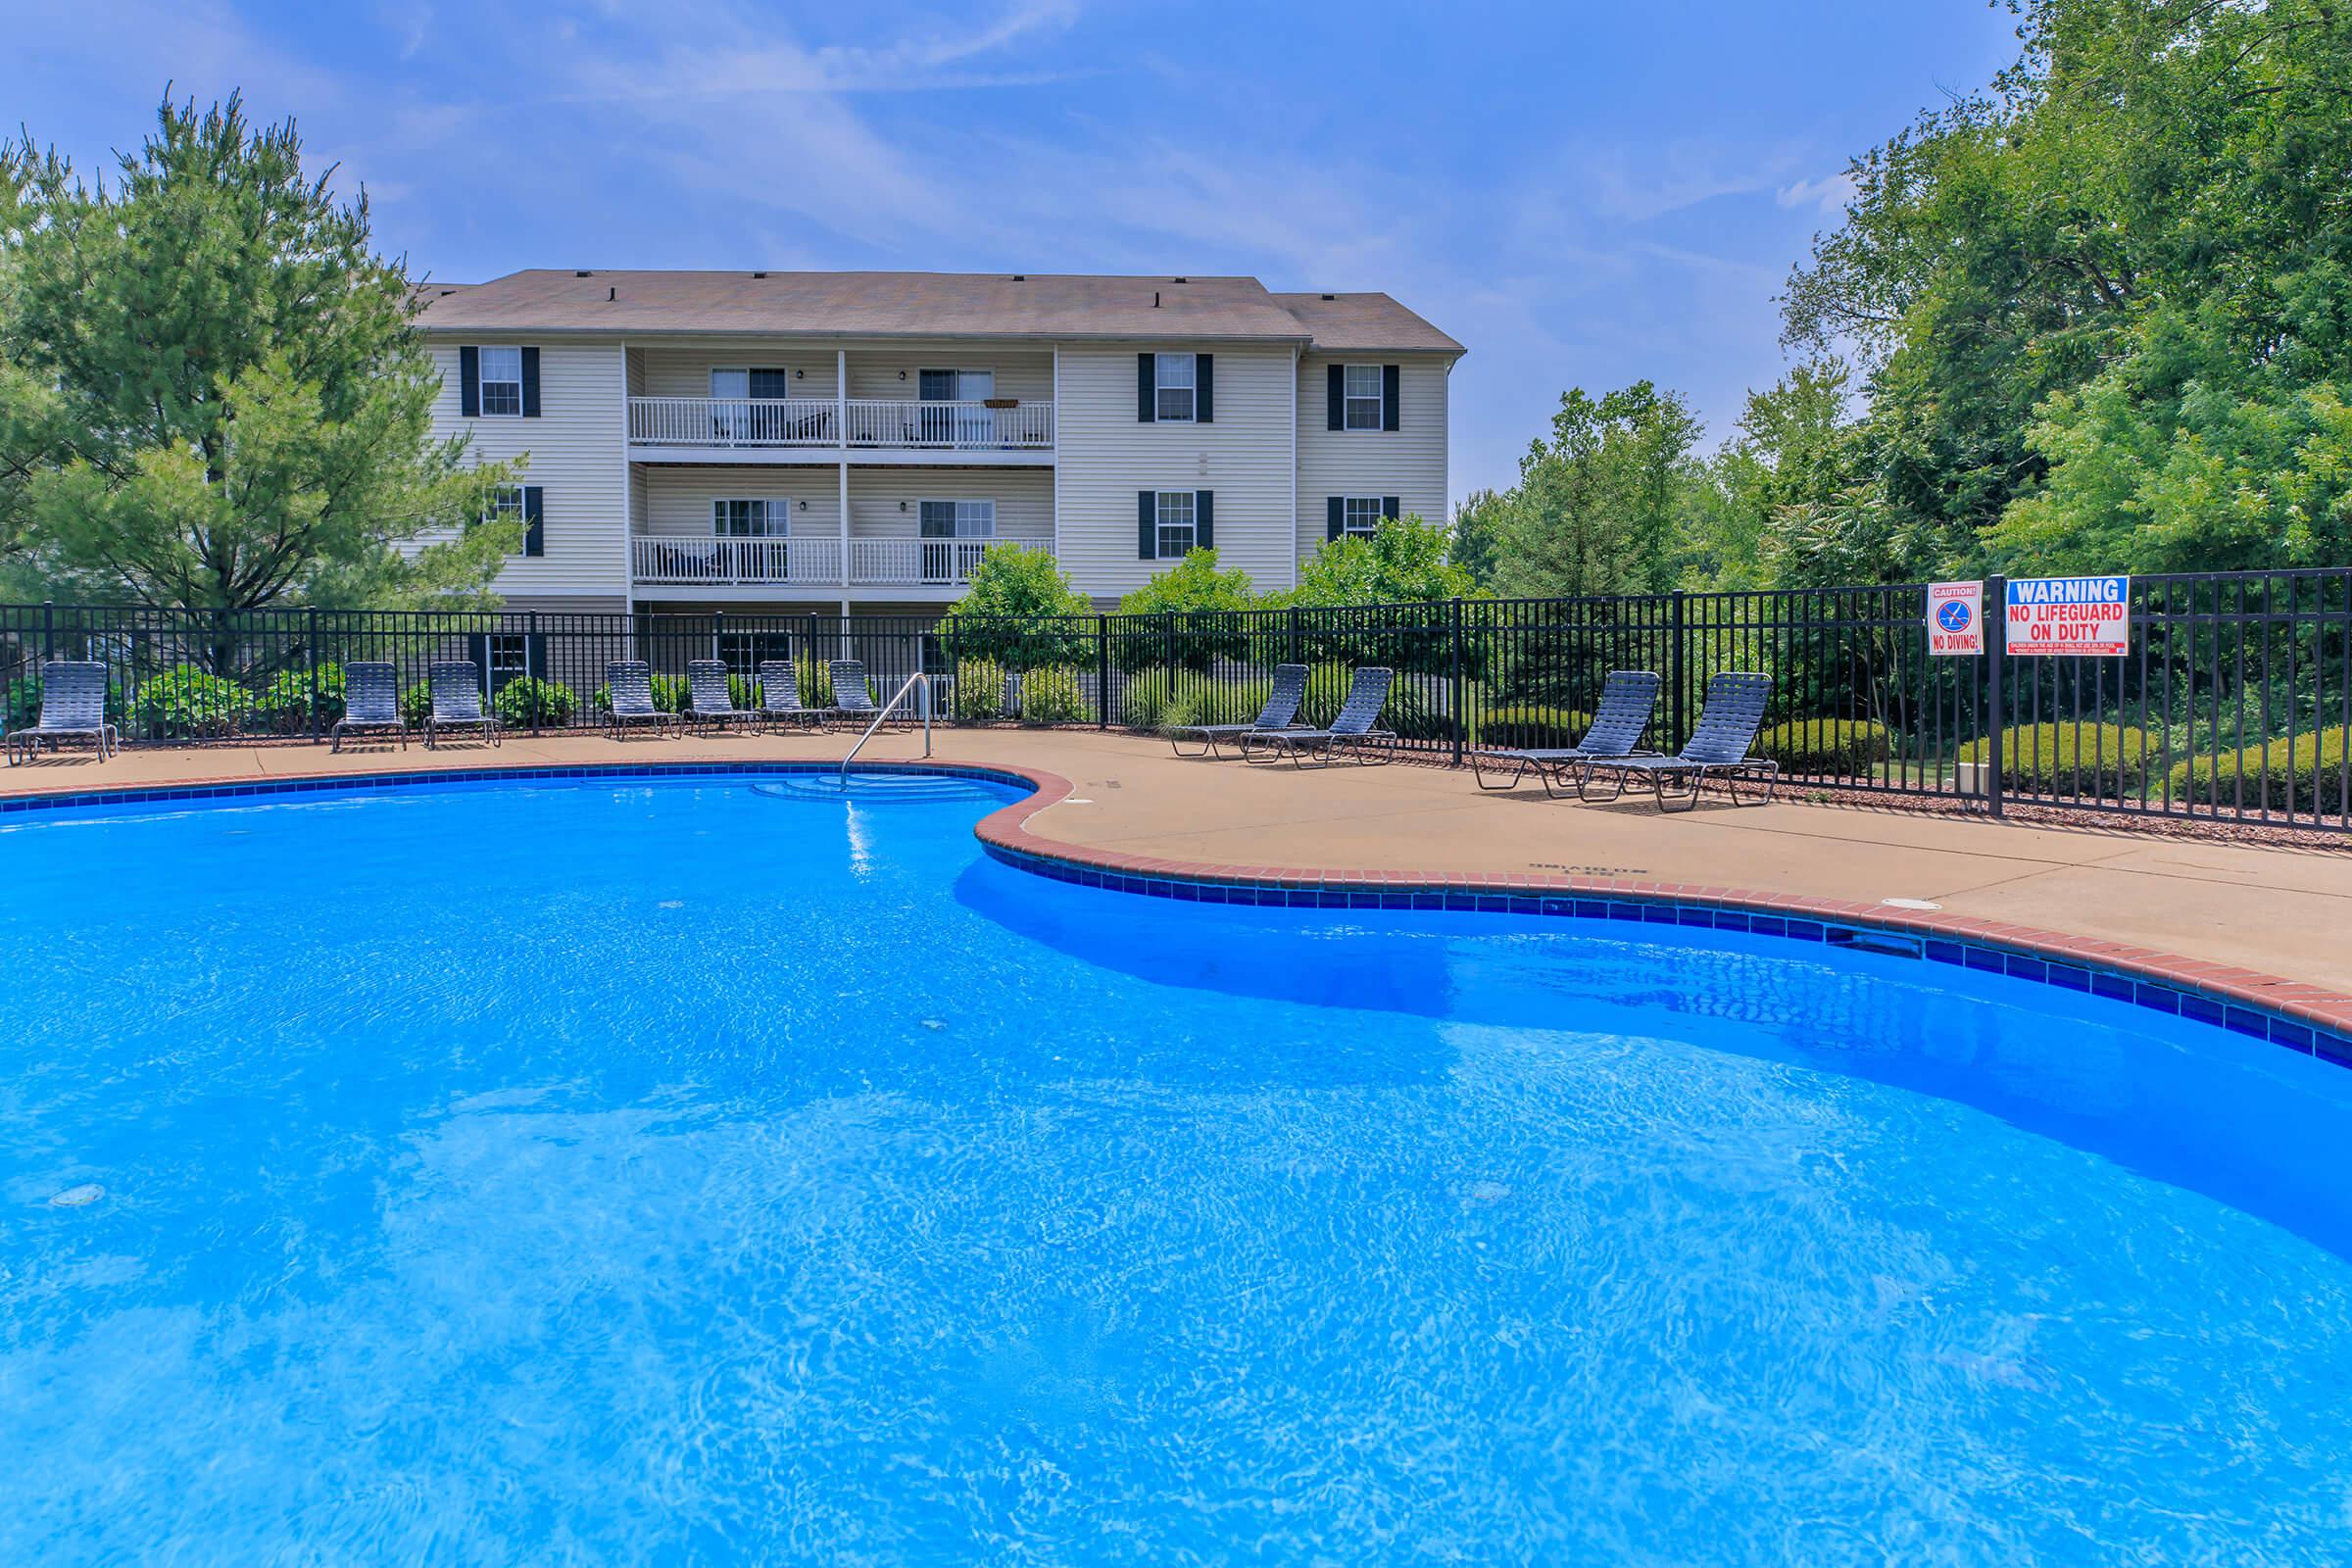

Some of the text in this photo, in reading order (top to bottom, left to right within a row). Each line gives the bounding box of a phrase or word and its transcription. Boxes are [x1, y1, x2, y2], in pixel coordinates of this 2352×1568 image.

[1935, 587, 1976, 597] CAUTION!
[2017, 579, 2119, 603] WARNING
[2009, 604, 2123, 622] NO LIFEGUARD
[2031, 622, 2100, 641] ON DUTY
[1934, 634, 1978, 651] NO DIVING!
